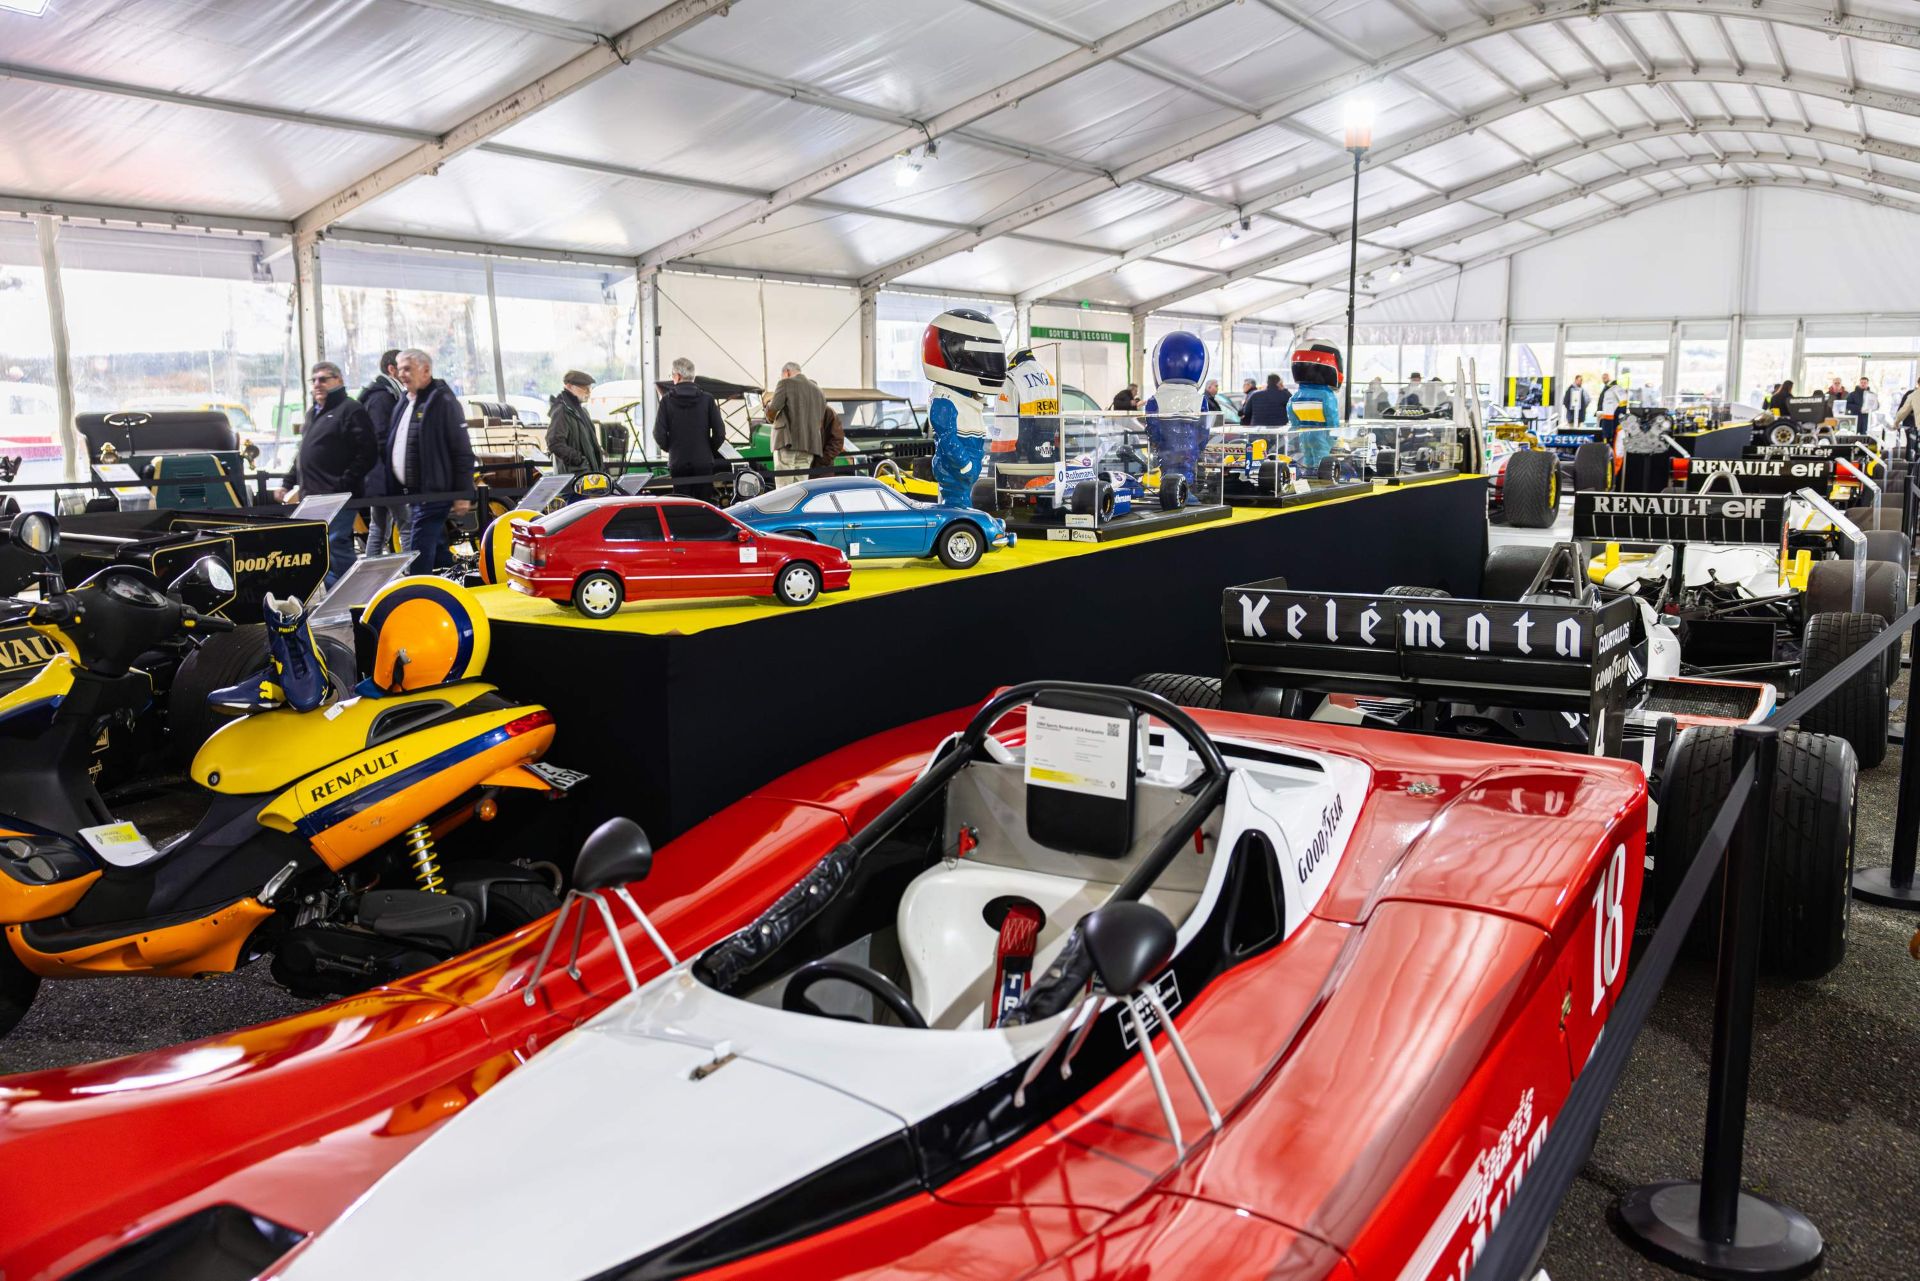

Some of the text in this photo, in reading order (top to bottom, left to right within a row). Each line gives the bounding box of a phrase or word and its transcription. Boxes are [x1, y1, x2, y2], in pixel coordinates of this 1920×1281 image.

[1023, 371, 1049, 389] ING
[1815, 448, 1833, 458] elf
[1690, 460, 1825, 478] RENAULT elf
[1593, 496, 1766, 519] RENAULT elf
[311, 750, 399, 803] RENAULT
[1298, 793, 1343, 884] GOODYEAR
[1591, 843, 1626, 1017] 18
